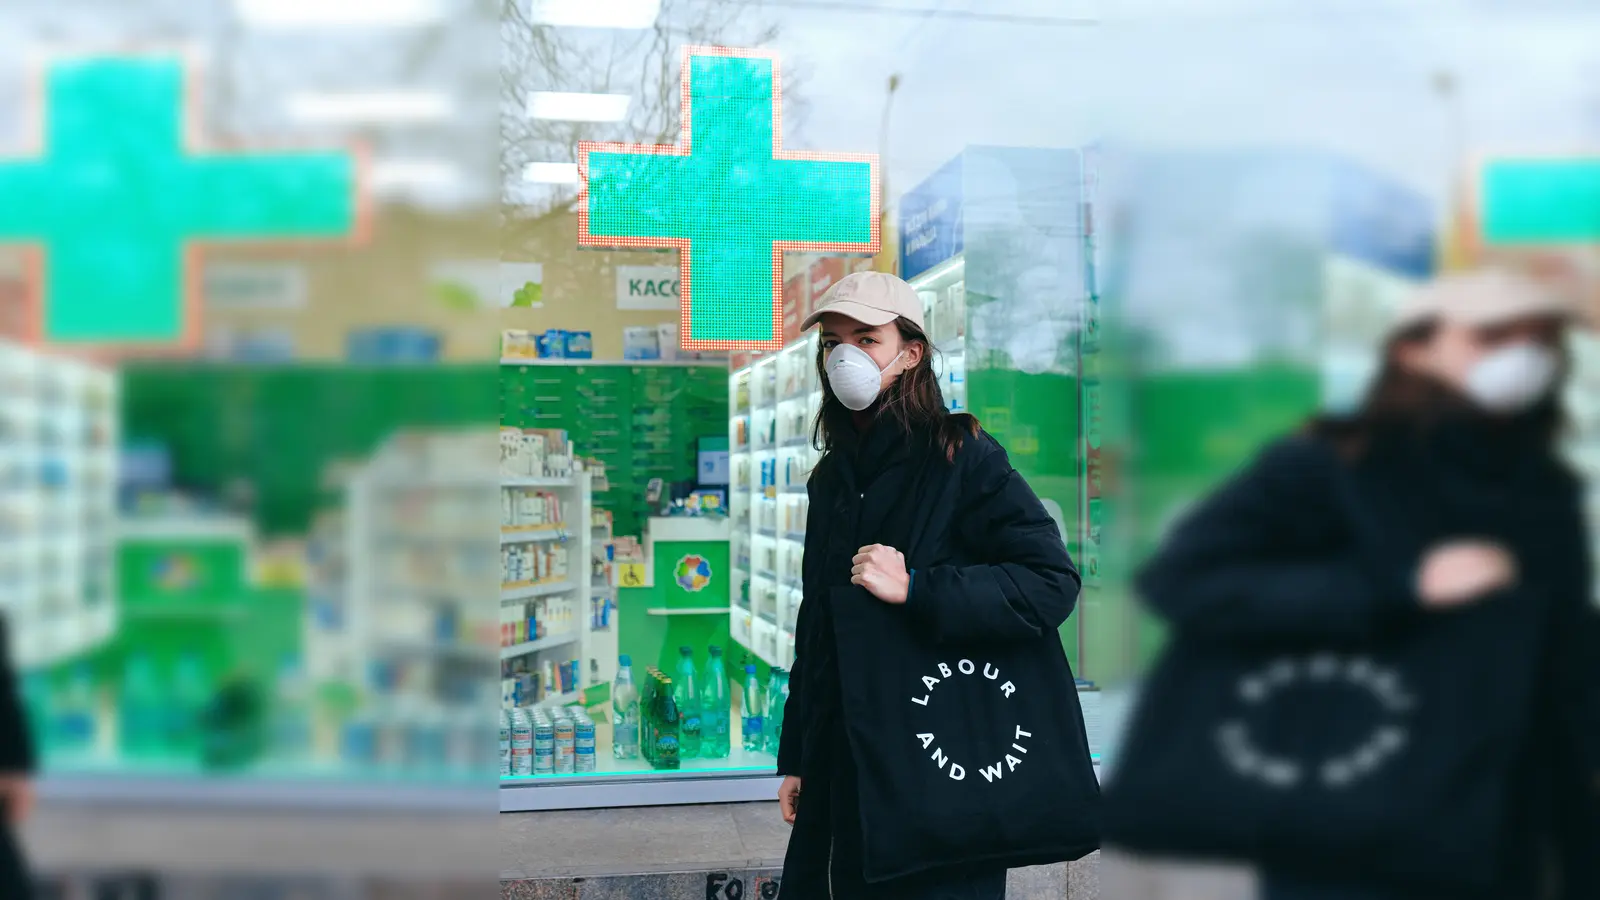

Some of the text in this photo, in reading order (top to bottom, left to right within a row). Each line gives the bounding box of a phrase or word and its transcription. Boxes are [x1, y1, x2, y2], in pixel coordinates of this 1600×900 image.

[911, 659, 1016, 706] LABOUR
[916, 725, 1032, 783] AND WAIT
